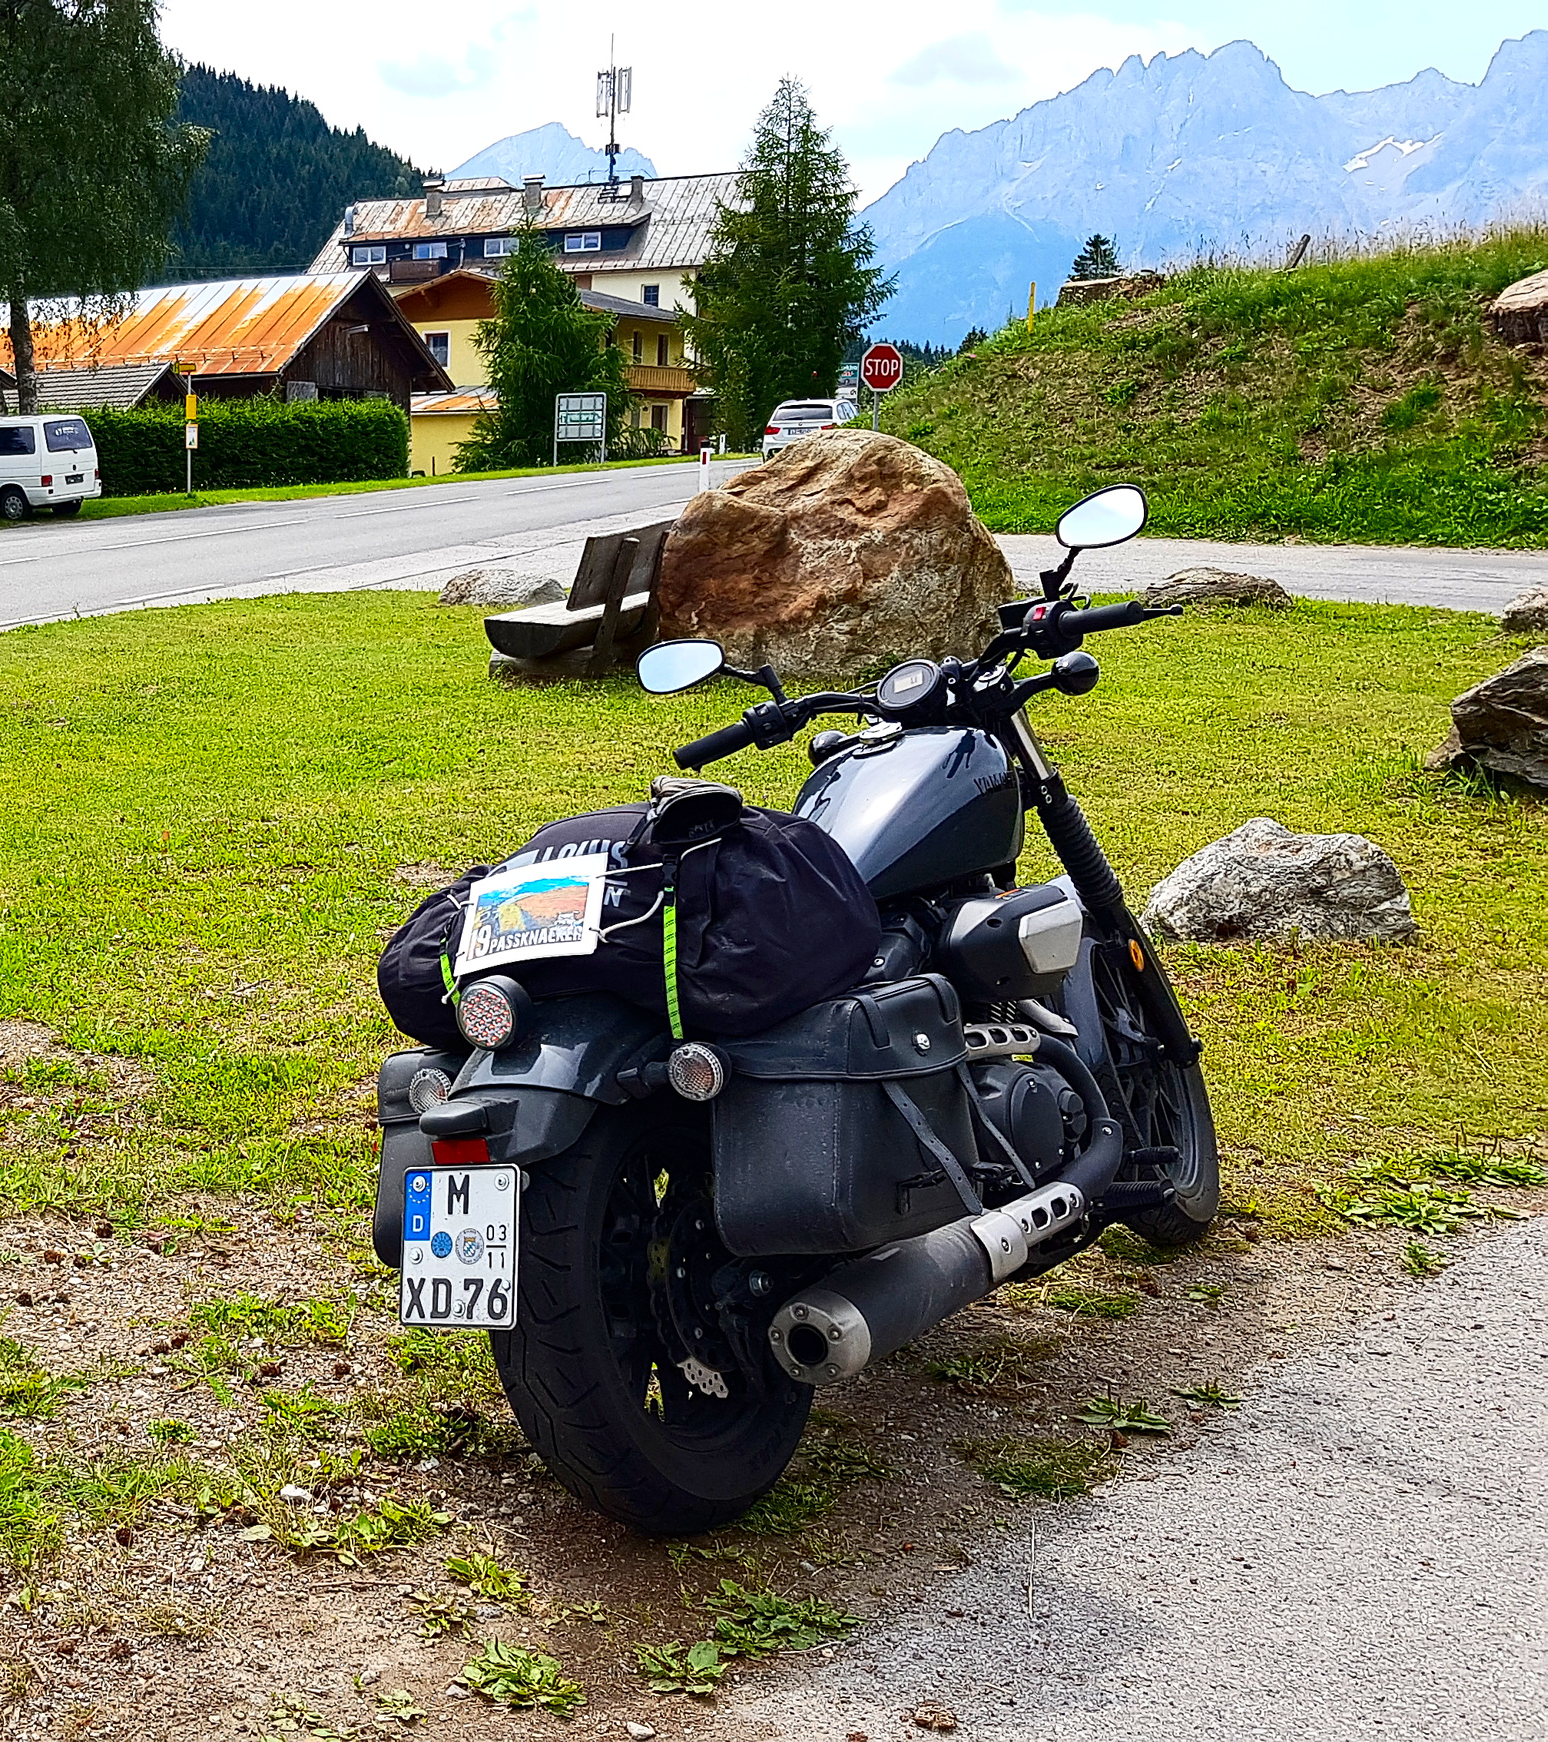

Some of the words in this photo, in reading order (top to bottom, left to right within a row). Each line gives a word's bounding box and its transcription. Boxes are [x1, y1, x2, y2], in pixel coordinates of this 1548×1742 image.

[865, 359, 899, 376] STOP
[447, 1174, 470, 1215] M
[412, 1215, 424, 1232] D
